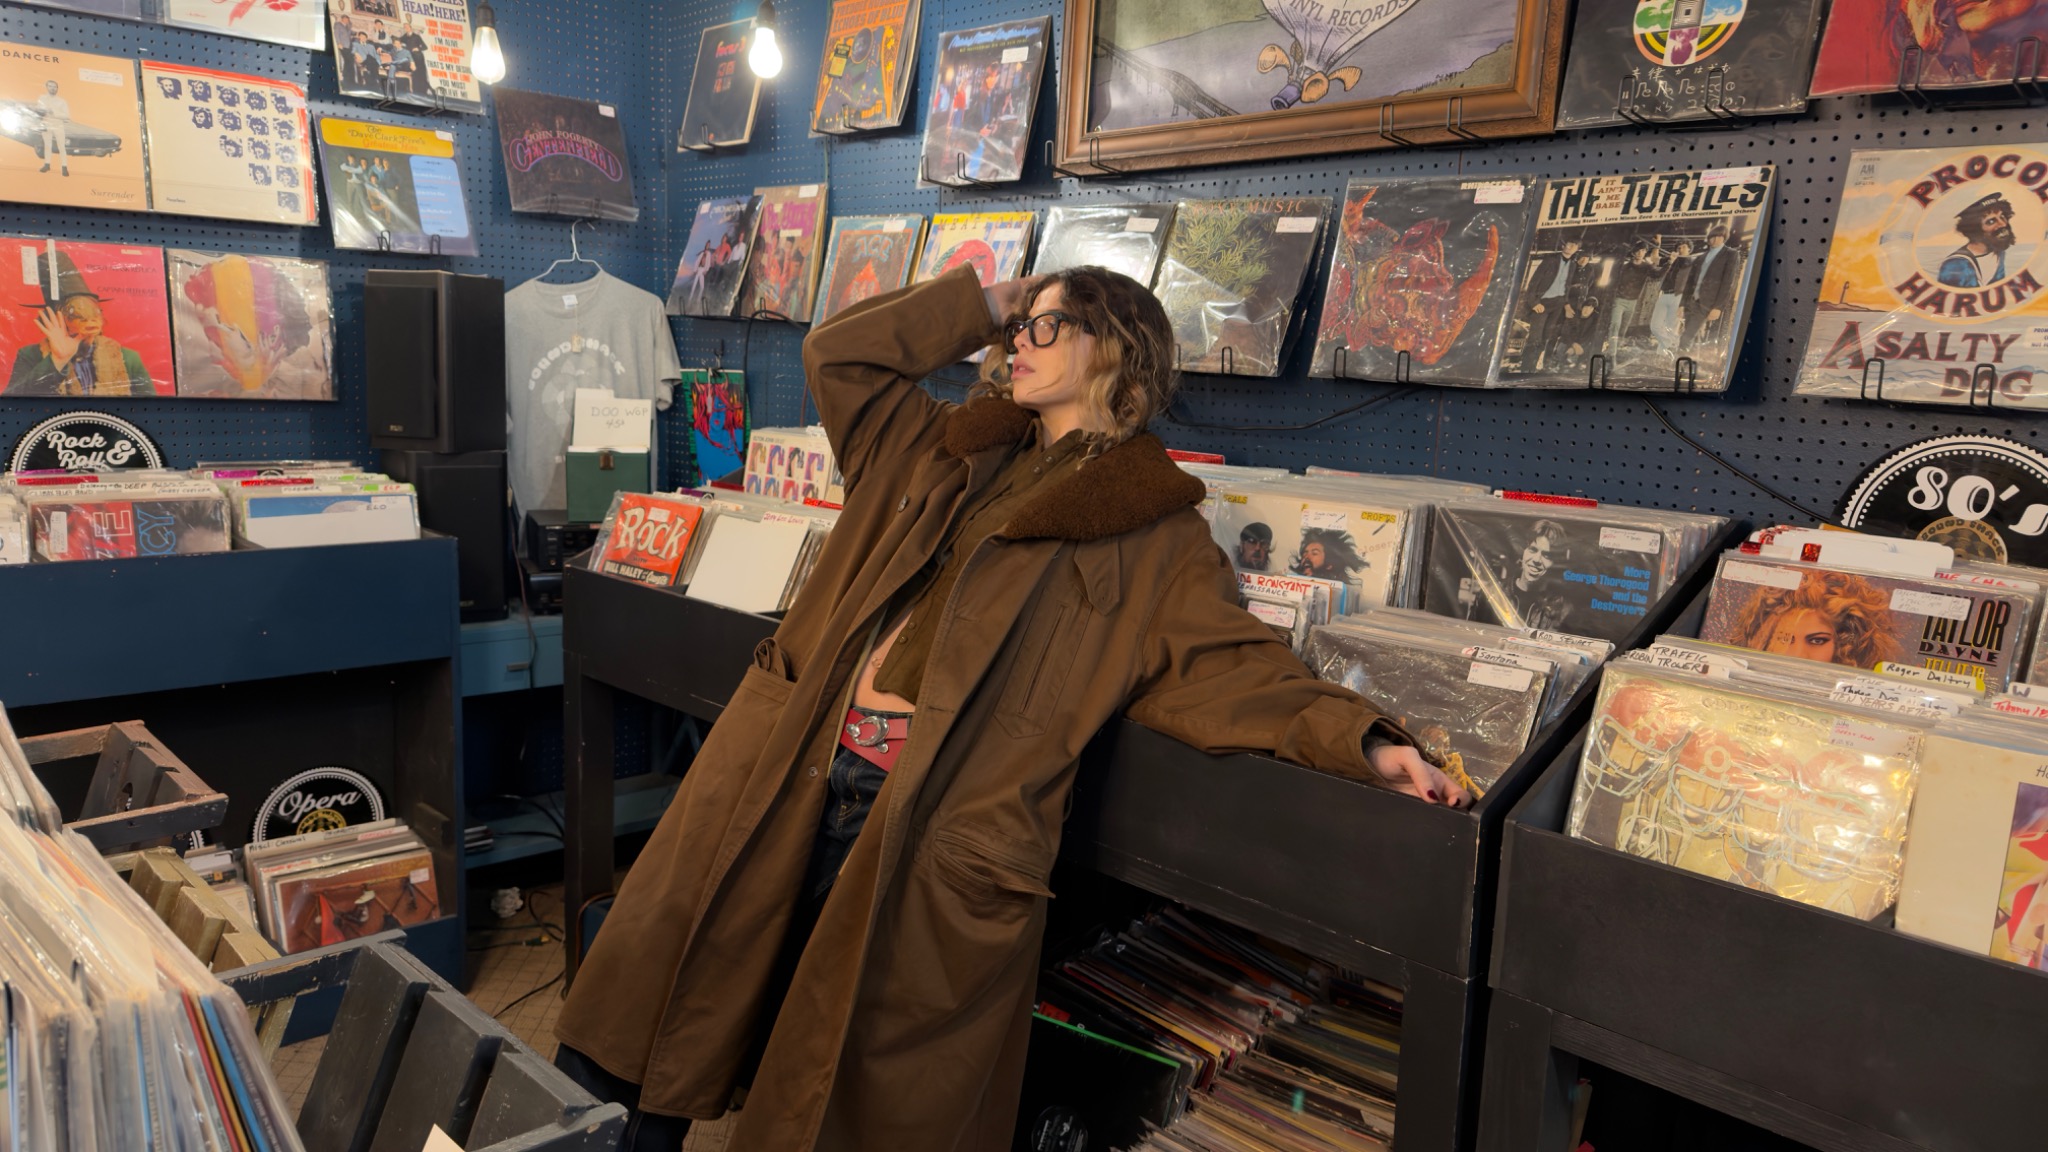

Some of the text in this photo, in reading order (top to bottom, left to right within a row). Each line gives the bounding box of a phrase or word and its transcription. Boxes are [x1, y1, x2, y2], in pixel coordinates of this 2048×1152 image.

[402, 1, 434, 17] HEAR!
[434, 6, 466, 23] HERE!
[831, 14, 866, 35] ECHOES
[3, 50, 60, 63] DANCER
[555, 131, 599, 150] FOGERTY
[90, 187, 135, 199] Surrender
[1548, 167, 1771, 221] THE TURTLES
[1598, 186, 1625, 194] AIN'T
[1246, 199, 1306, 215] MUSIC
[1595, 201, 1622, 210] BABE
[1681, 210, 1719, 218] Destruction
[1895, 268, 2044, 318] HARUM
[1818, 320, 2022, 370] A SALTY
[1940, 367, 2034, 401] DOG
[591, 406, 649, 418] DOO WOP
[47, 430, 136, 465] Rock &
[59, 449, 106, 470] Roll
[1360, 510, 1396, 523] CROFTS
[616, 506, 688, 560] ROCK
[604, 561, 619, 573] BILL
[619, 563, 643, 579] HALEY
[1624, 566, 1651, 579] More
[1563, 570, 1650, 591] George Thorogood
[1591, 598, 1646, 616] Destroyers
[1612, 591, 1648, 605] and the
[1538, 631, 1594, 647] ROD STEWART
[1478, 651, 1518, 665] Santana
[1629, 650, 1655, 664] ROBIN
[1653, 646, 1709, 663] TRAFFIC
[1919, 641, 2000, 663] DAYNE
[1887, 662, 1971, 688] Roger Daltry
[1832, 691, 1857, 703] TEN
[1859, 696, 1894, 710] YEARS
[1897, 705, 1942, 719] AFTER
[278, 791, 362, 823] Opera
